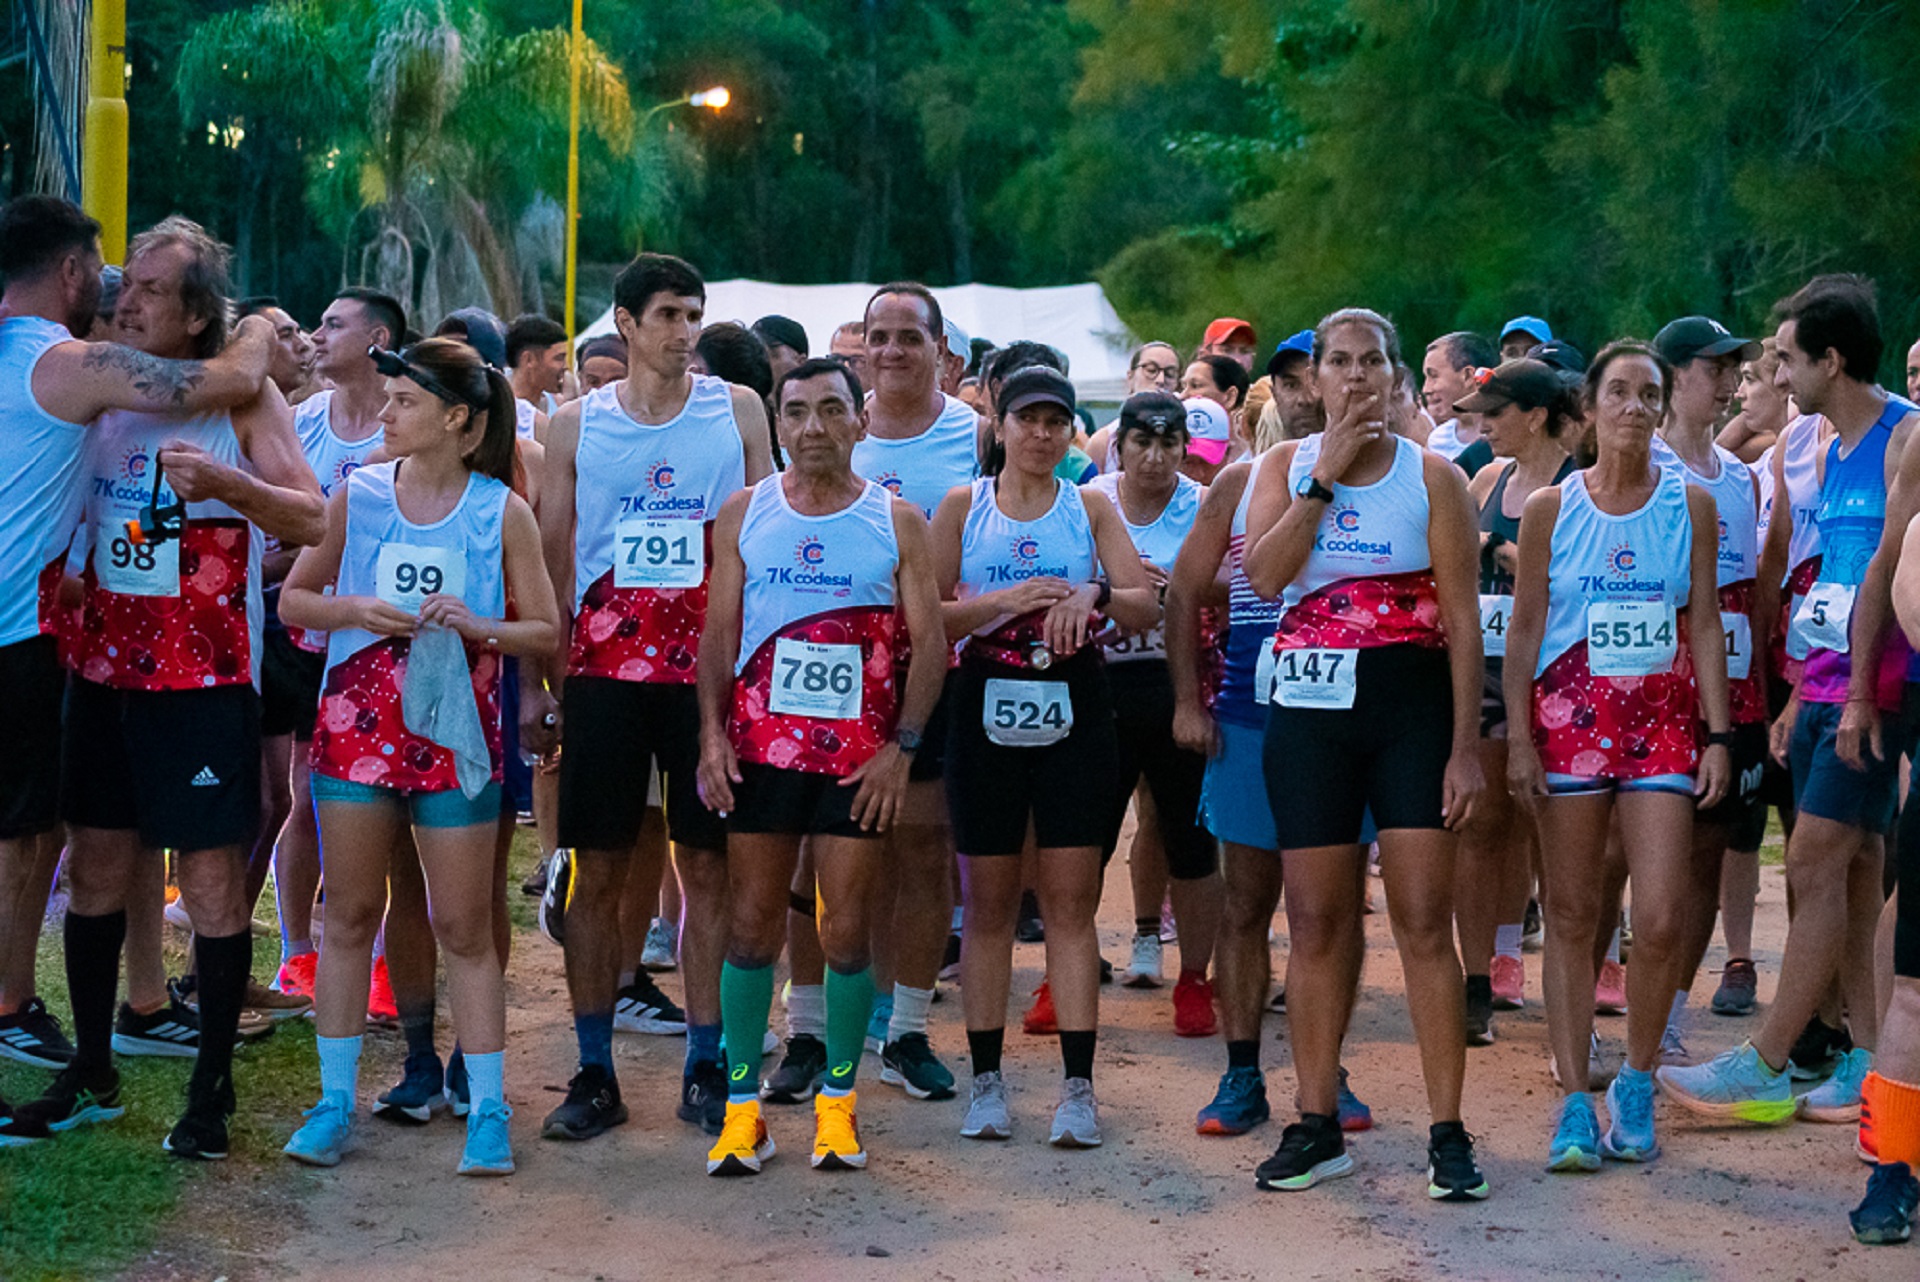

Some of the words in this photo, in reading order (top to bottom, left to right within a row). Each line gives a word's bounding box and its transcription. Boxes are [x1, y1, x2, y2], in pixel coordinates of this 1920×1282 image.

[94, 477, 116, 498] 7K
[116, 486, 172, 506] codeal
[619, 495, 646, 513] 7K
[647, 494, 706, 512] codesal
[110, 537, 156, 571] 98
[621, 535, 696, 566] 791
[1326, 538, 1393, 556] codesal
[395, 562, 444, 596] 99
[765, 567, 793, 584] 7K
[794, 571, 853, 588] codesal
[985, 564, 1012, 583] 7K
[1578, 575, 1606, 593] 7K
[1606, 579, 1666, 593] codesal
[1589, 621, 1673, 649] 5514
[780, 656, 853, 696] 786
[1283, 652, 1345, 684] 147
[994, 699, 1067, 730] 524
